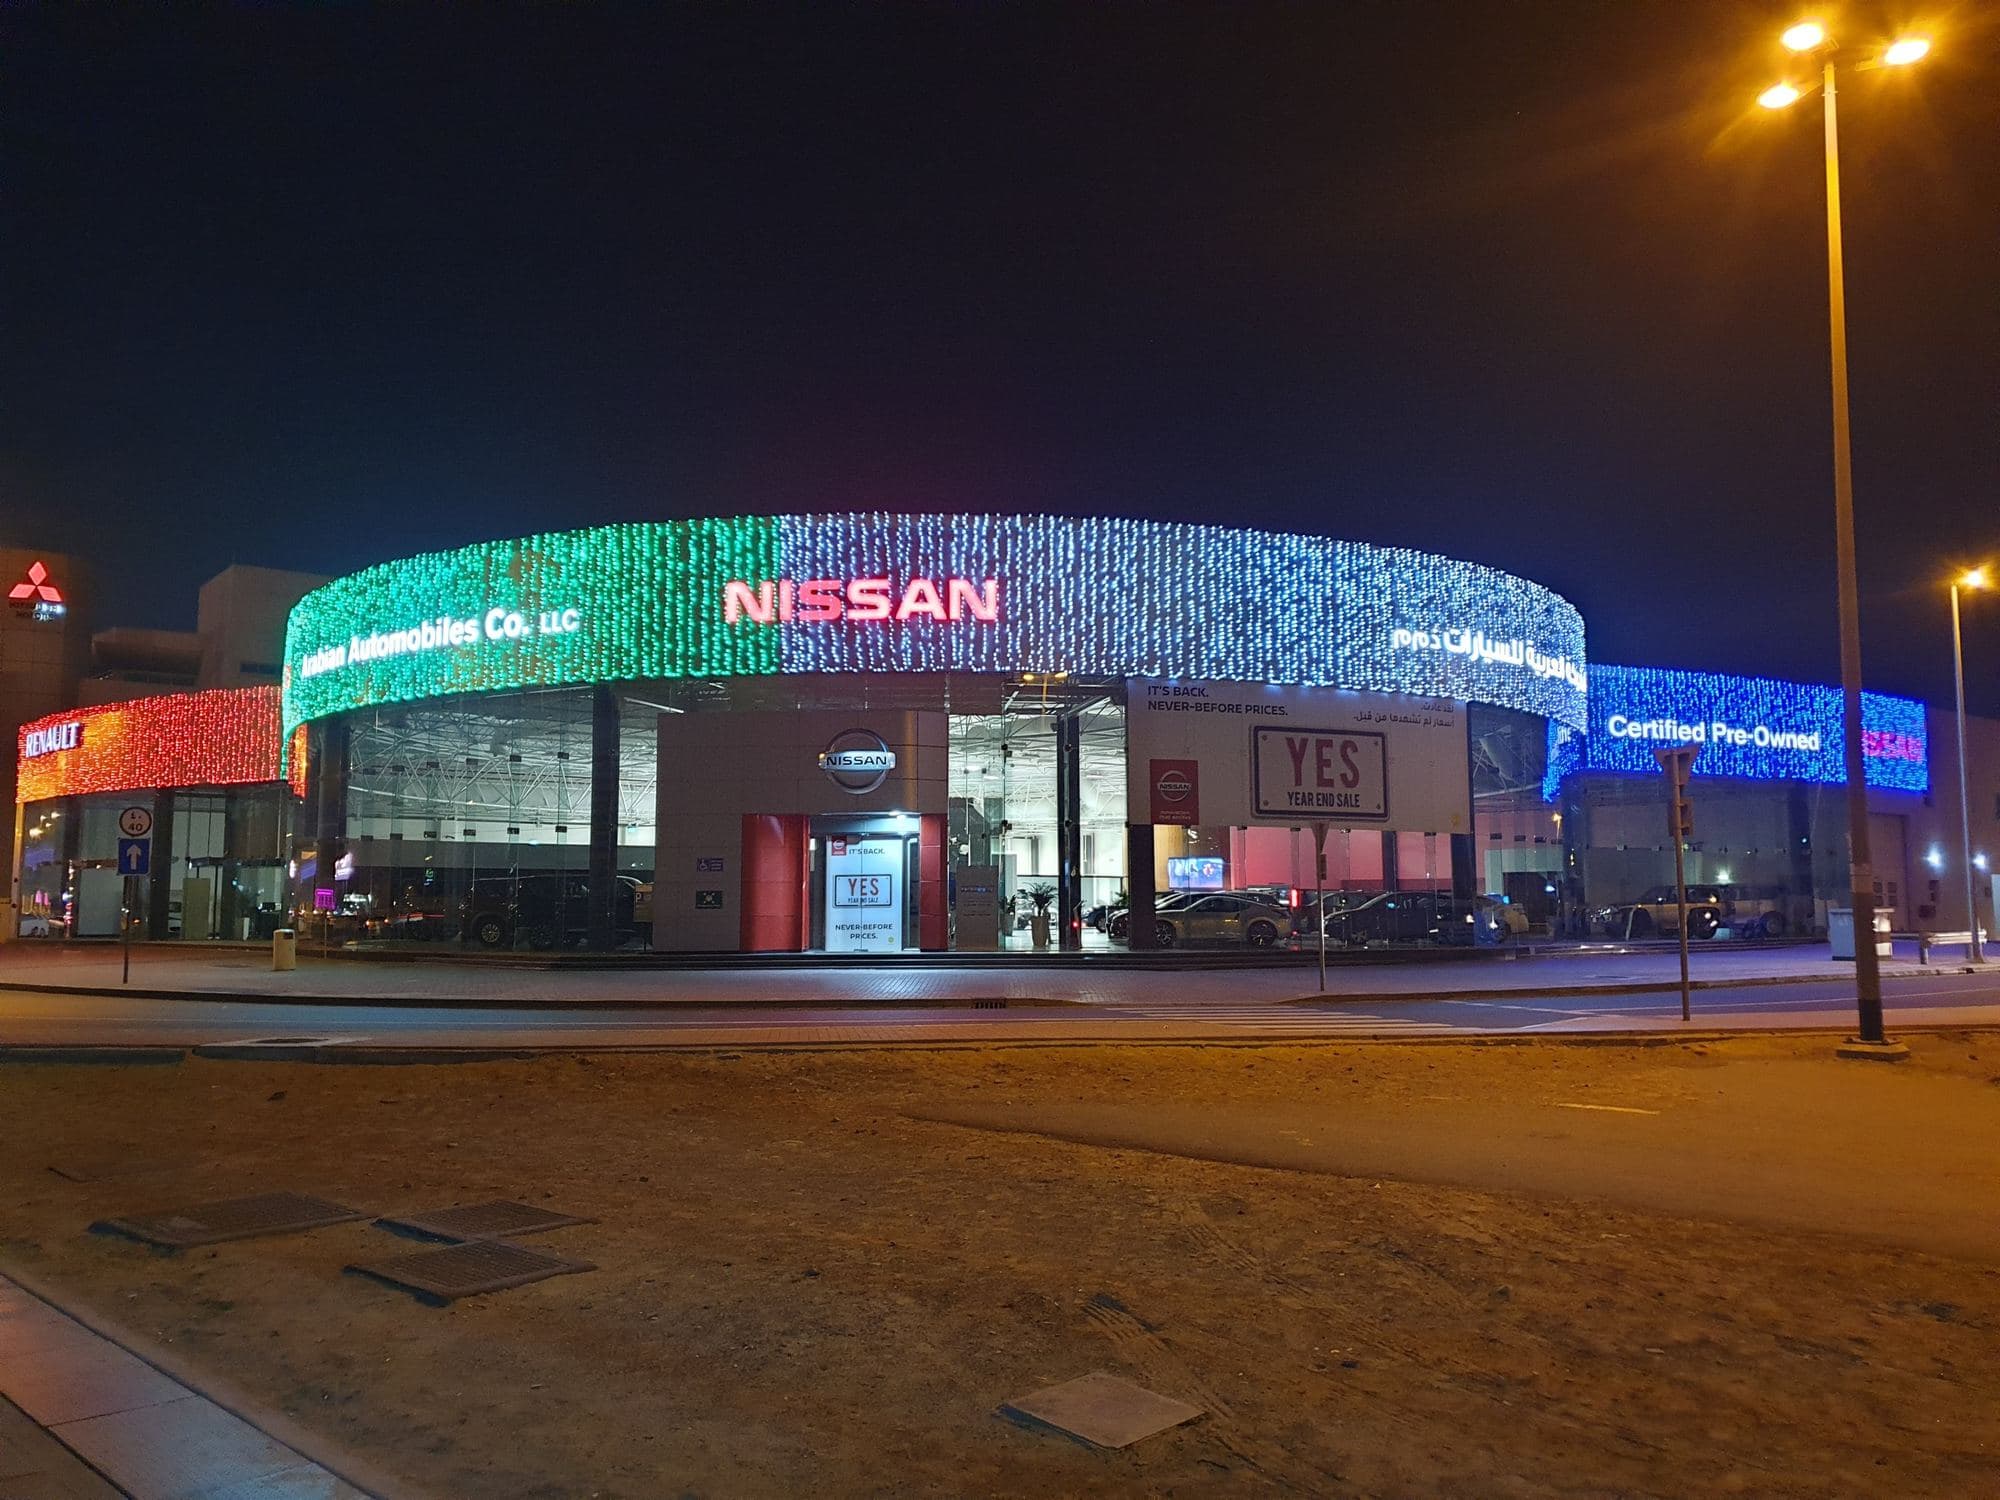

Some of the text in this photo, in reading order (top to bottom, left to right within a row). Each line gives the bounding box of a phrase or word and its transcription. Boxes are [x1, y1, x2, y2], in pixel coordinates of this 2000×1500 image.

[725, 579, 997, 623] NISSAN
[348, 616, 479, 663] Automobiles
[485, 608, 529, 639] Co.
[539, 608, 580, 633] LLC
[1443, 627, 1524, 666] للسيارات
[1148, 685, 1209, 698] IT'S BACK.
[1148, 701, 1289, 716] NEVER-BEFORE PRICES.
[1375, 713, 1387, 723] من
[26, 722, 80, 758] RENAULT
[1608, 716, 1821, 751] Certified Pre-Owned
[1861, 730, 1923, 763] ISSAN
[826, 756, 887, 766] NISSAN
[1285, 736, 1360, 789] YES
[1287, 791, 1360, 808] YEAR END SALE
[129, 823, 143, 831] 40
[848, 878, 879, 896] YES
